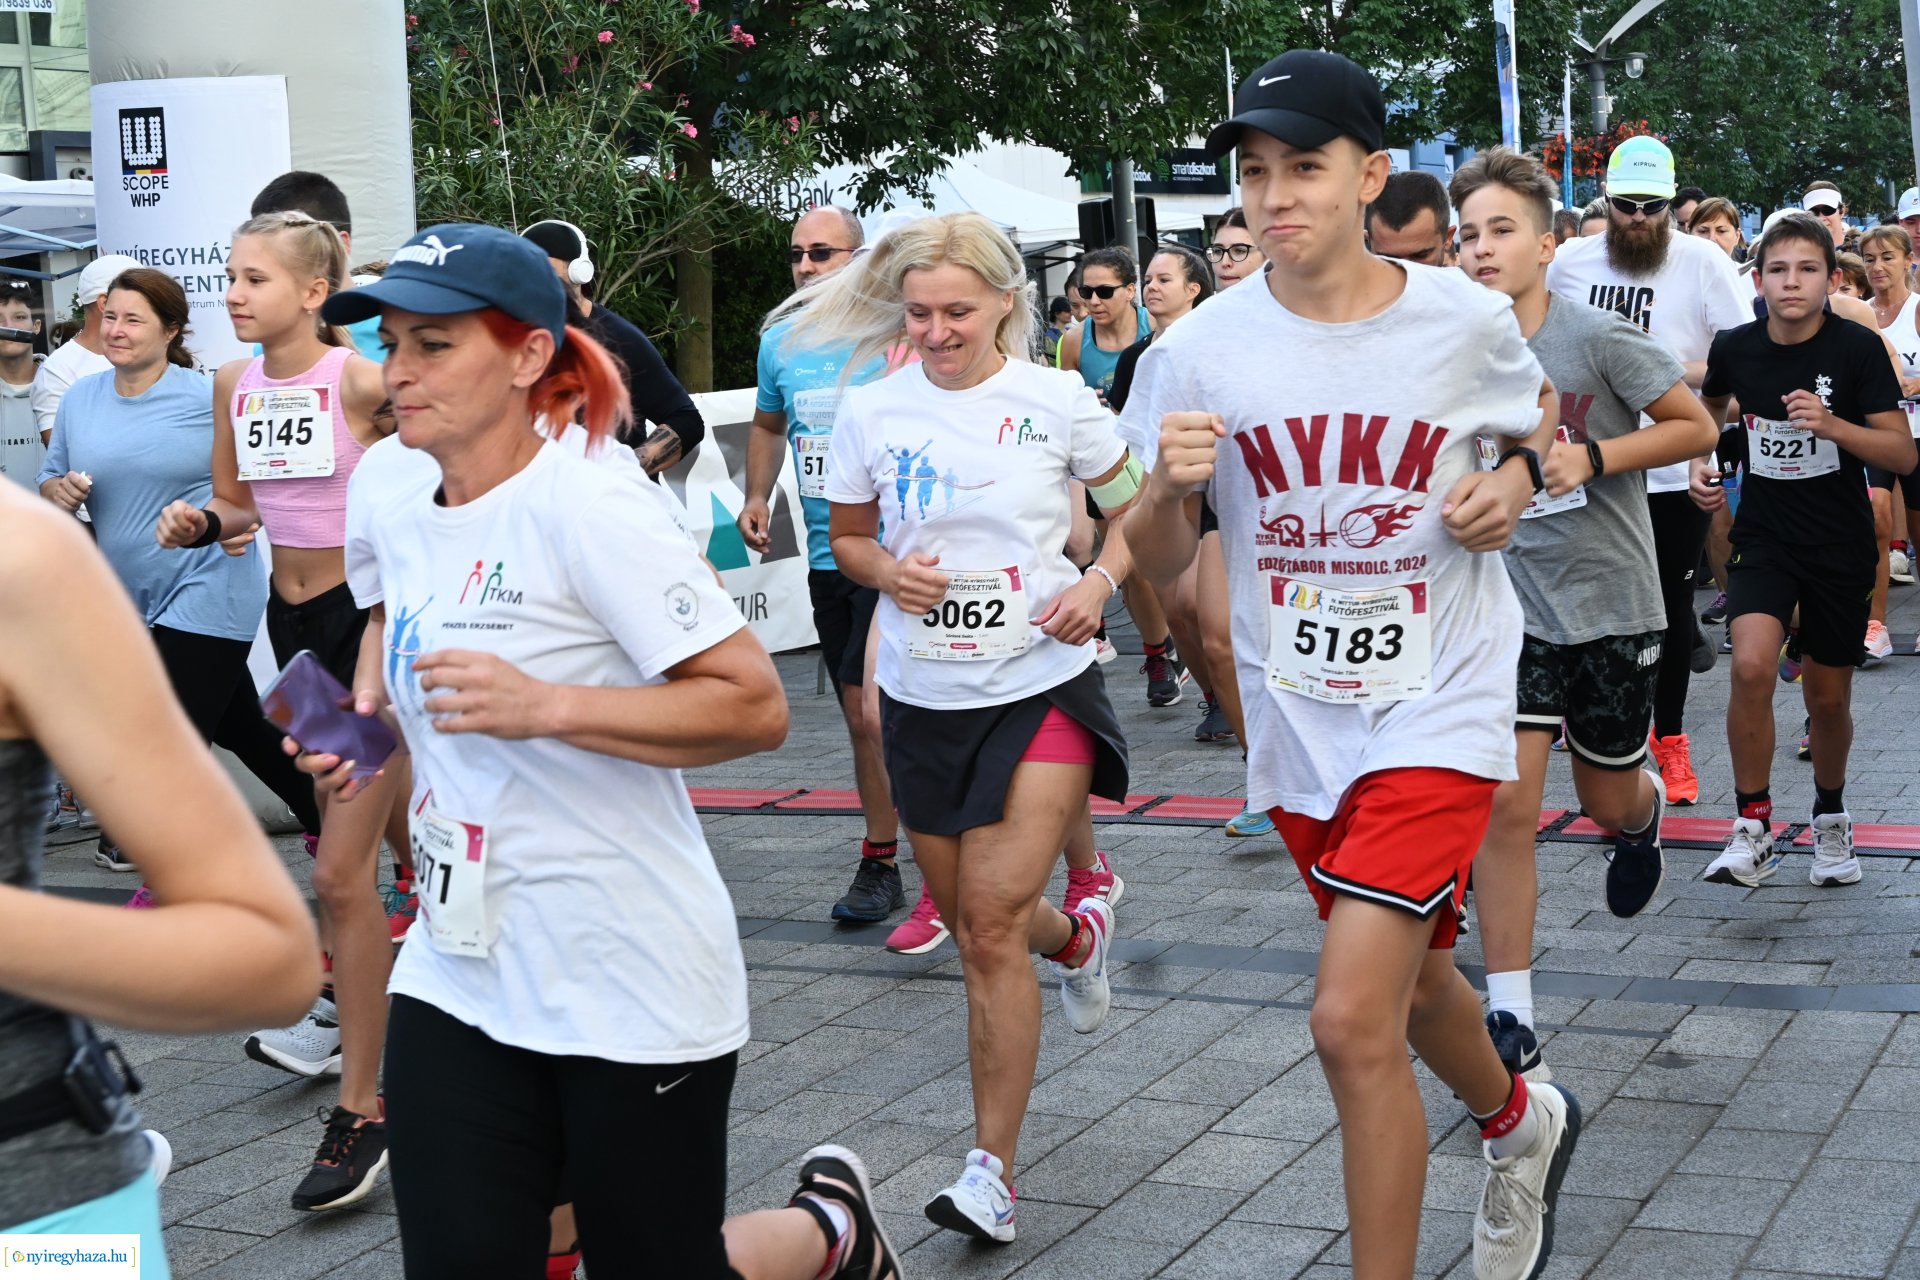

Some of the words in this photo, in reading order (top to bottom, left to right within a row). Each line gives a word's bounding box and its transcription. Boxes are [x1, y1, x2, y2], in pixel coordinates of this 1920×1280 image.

[122, 175, 169, 191] SCOPE
[130, 192, 161, 207] WHP
[174, 275, 227, 293] ENT
[248, 417, 314, 449] 5145
[1024, 433, 1048, 443] TKM
[1233, 412, 1450, 499] NYKK
[1760, 436, 1817, 459] 5221
[1257, 557, 1326, 575] EDZŐTÁBOR
[1331, 561, 1392, 575] MISKOLC,
[1394, 554, 1427, 572] 2024
[489, 587, 523, 605] TKM
[946, 583, 1002, 592] FUTÓFESZTIVÁL
[922, 599, 1006, 630] 5062
[1328, 602, 1401, 617] FUTÓFESZTIVÁL
[1294, 618, 1404, 665] 5183
